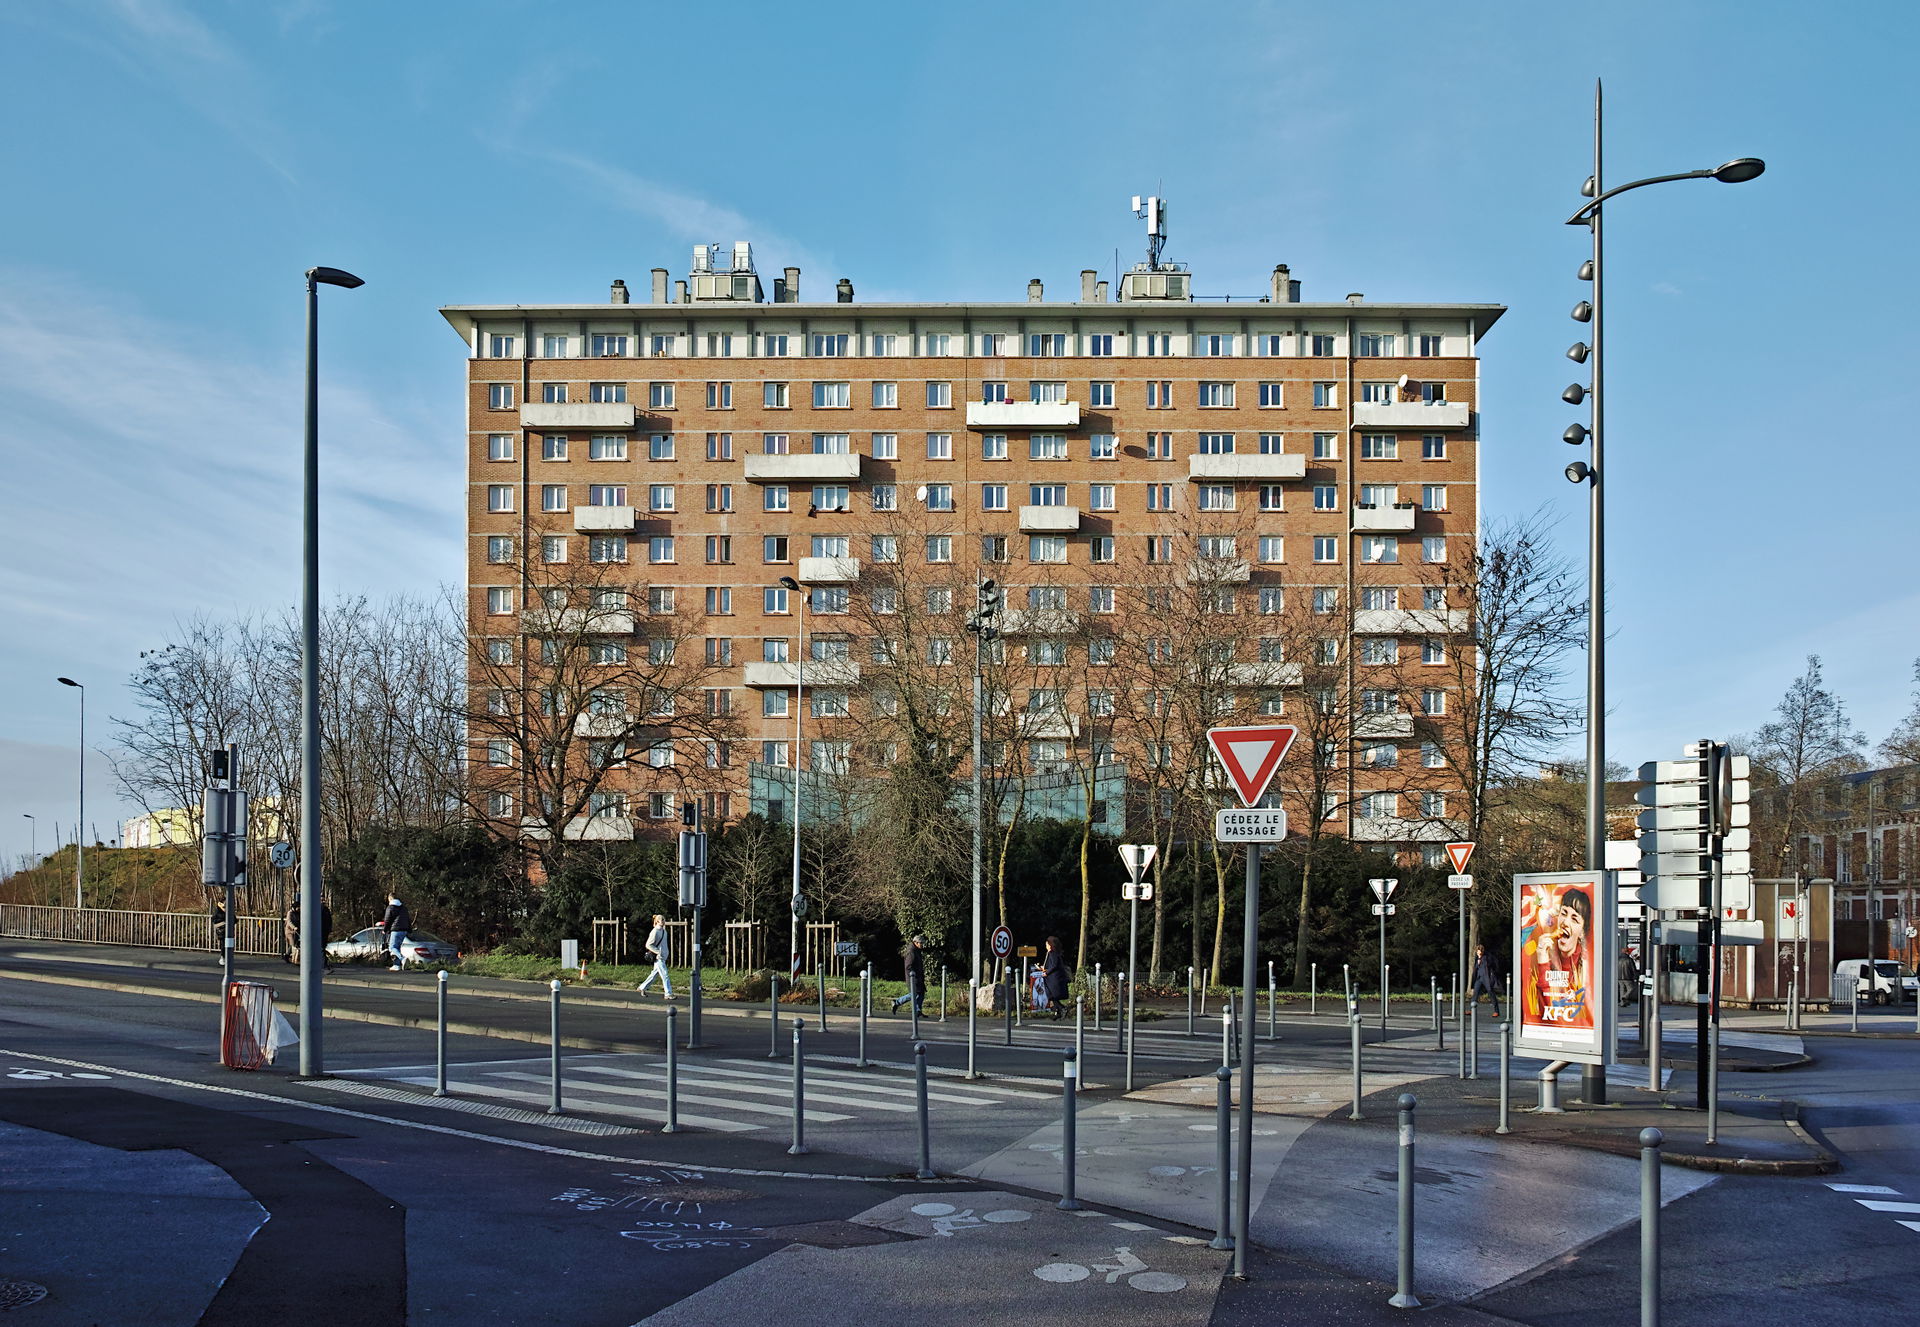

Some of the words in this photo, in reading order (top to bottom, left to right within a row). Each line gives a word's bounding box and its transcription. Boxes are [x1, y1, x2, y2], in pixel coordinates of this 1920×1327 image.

[1224, 813, 1260, 824] CÉDEZ
[1266, 815, 1279, 824] LE
[1225, 826, 1276, 836] PASSAGE
[276, 850, 290, 861] 30
[795, 901, 805, 910] 30
[996, 935, 1009, 950] 50
[836, 944, 857, 953] LILLE
[1542, 1006, 1576, 1022] KFC
